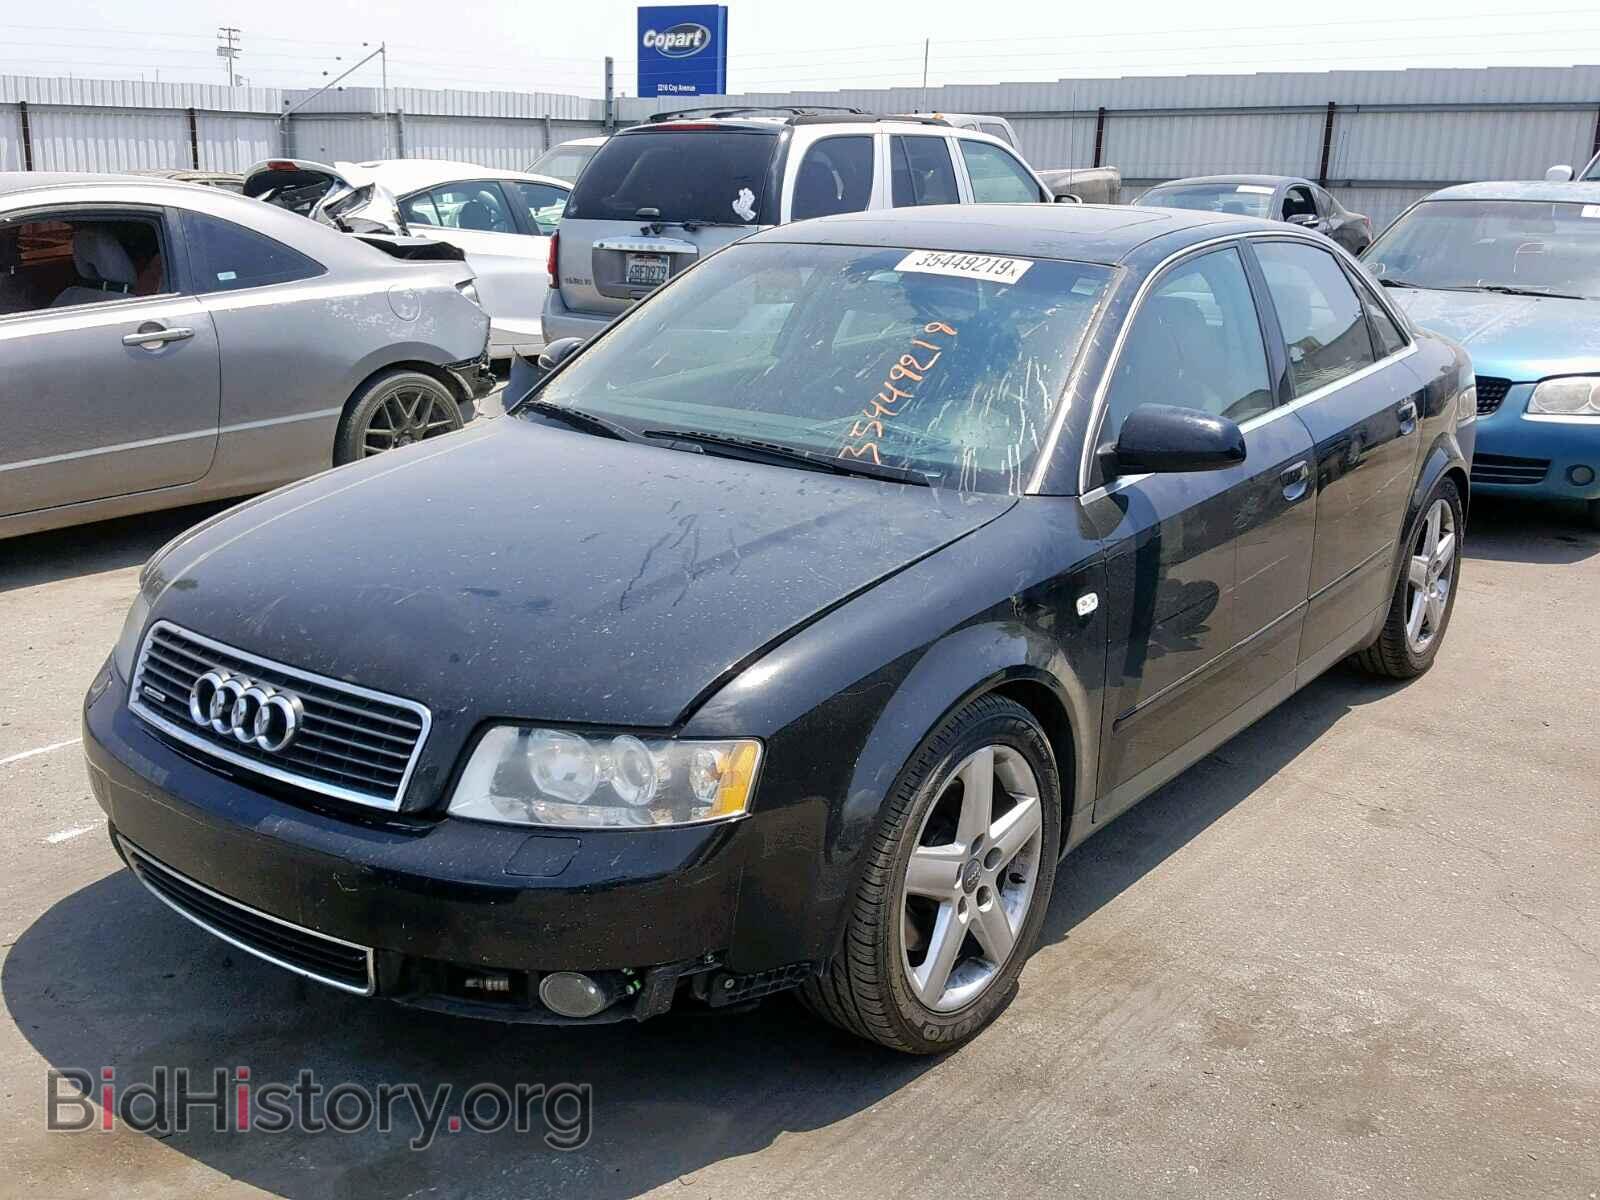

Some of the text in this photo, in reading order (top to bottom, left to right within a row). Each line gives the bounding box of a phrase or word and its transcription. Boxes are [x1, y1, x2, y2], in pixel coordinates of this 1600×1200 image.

[643, 29, 703, 52] Copart
[915, 253, 1015, 275] 35449219
[838, 321, 957, 465] 35449219
